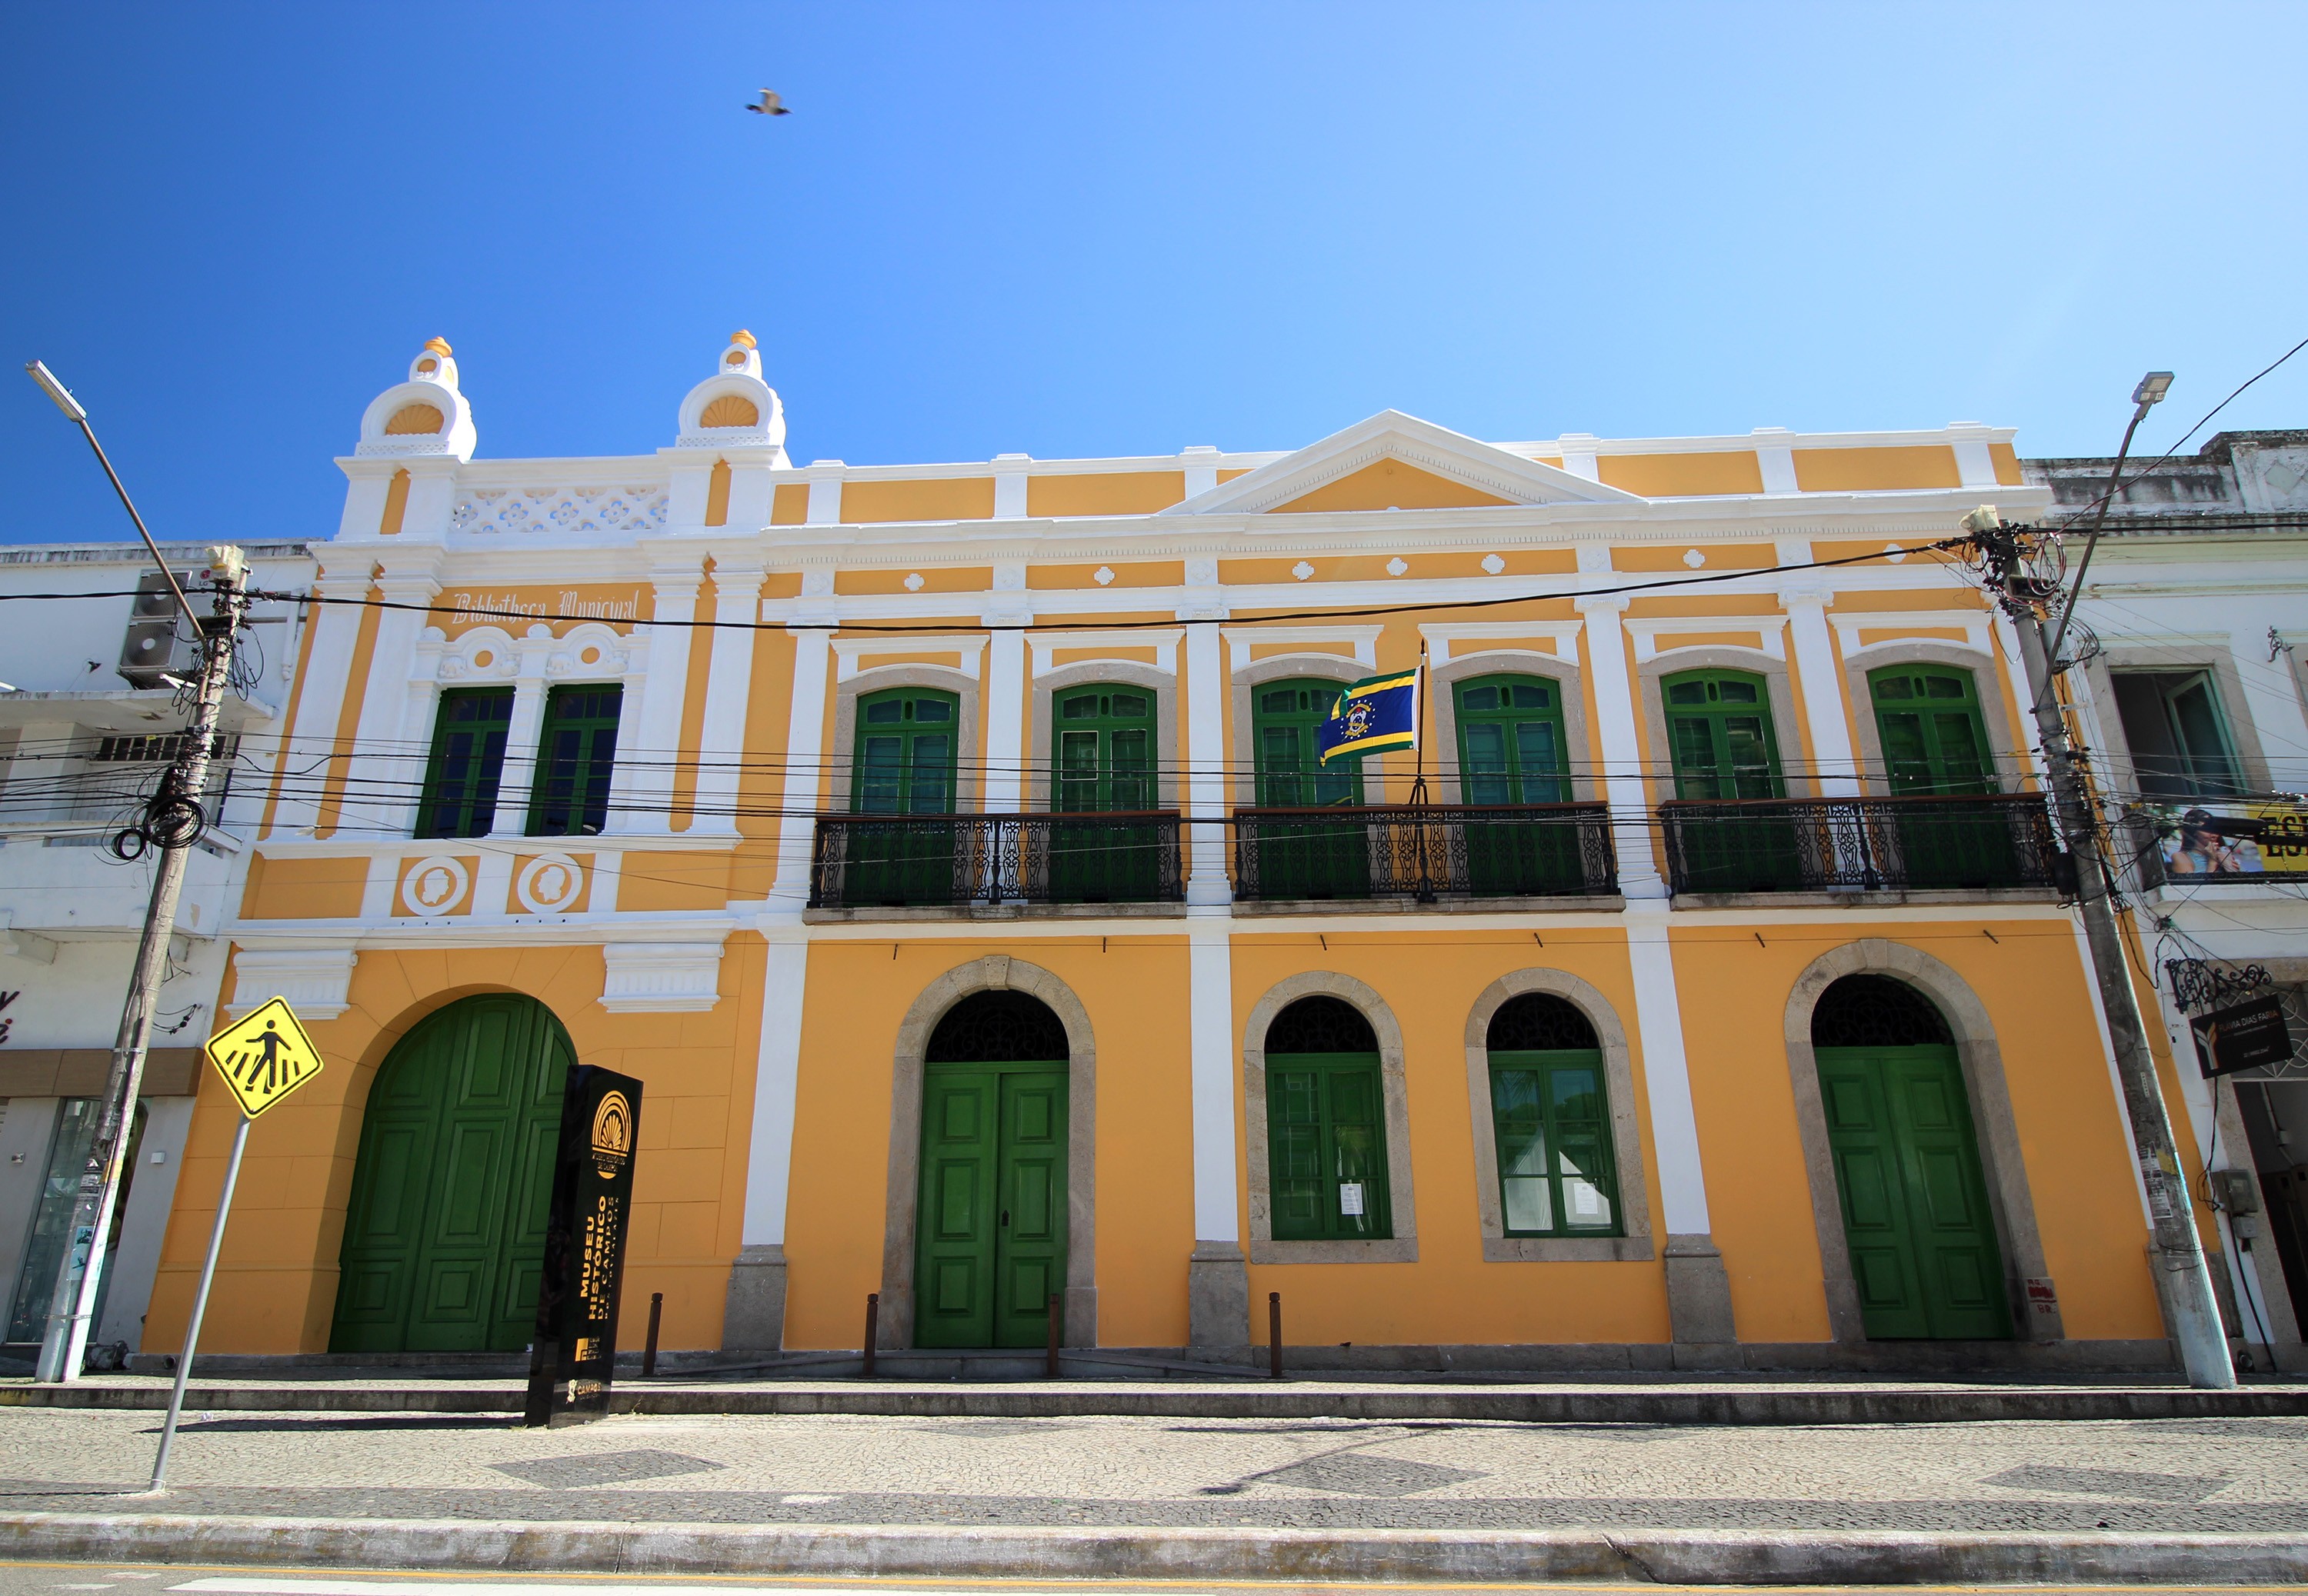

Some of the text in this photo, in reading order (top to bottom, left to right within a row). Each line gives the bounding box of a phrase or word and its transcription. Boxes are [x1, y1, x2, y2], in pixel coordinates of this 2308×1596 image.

[553, 590, 639, 625] Municipal
[580, 1216, 595, 1298] MUSEU
[589, 1195, 606, 1320] HISTÓRICO
[598, 1294, 605, 1320] DE
[602, 1197, 614, 1285] CAMPOS
[578, 1382, 602, 1395] CAMPOS
